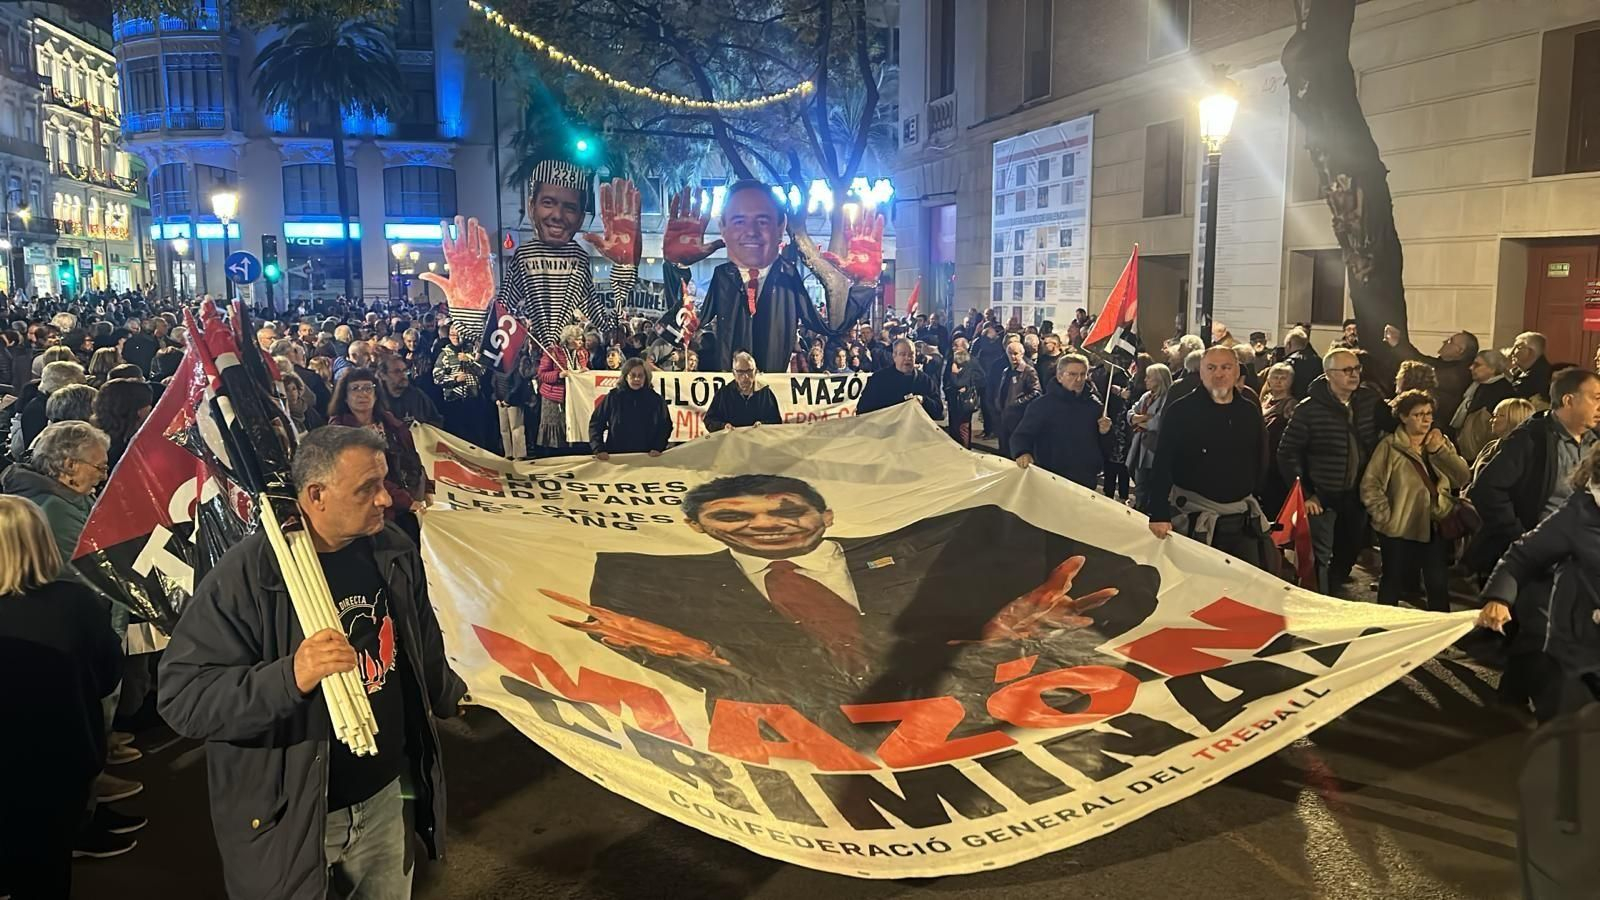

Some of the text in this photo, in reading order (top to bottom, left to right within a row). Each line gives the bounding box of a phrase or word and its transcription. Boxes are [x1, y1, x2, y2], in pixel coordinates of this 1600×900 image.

[553, 167, 577, 182] 228
[482, 314, 517, 367] CGT
[790, 373, 863, 405] MAZÓ
[507, 479, 688, 494] NOSTRES
[511, 490, 683, 506] DE FANG
[338, 595, 367, 610] DIRECTA
[471, 596, 1286, 771] MAZÓN
[500, 627, 1391, 830] CRIMINAL
[668, 686, 1331, 858] CONFEDERACIÓ GENERAL DEL TREBALL
